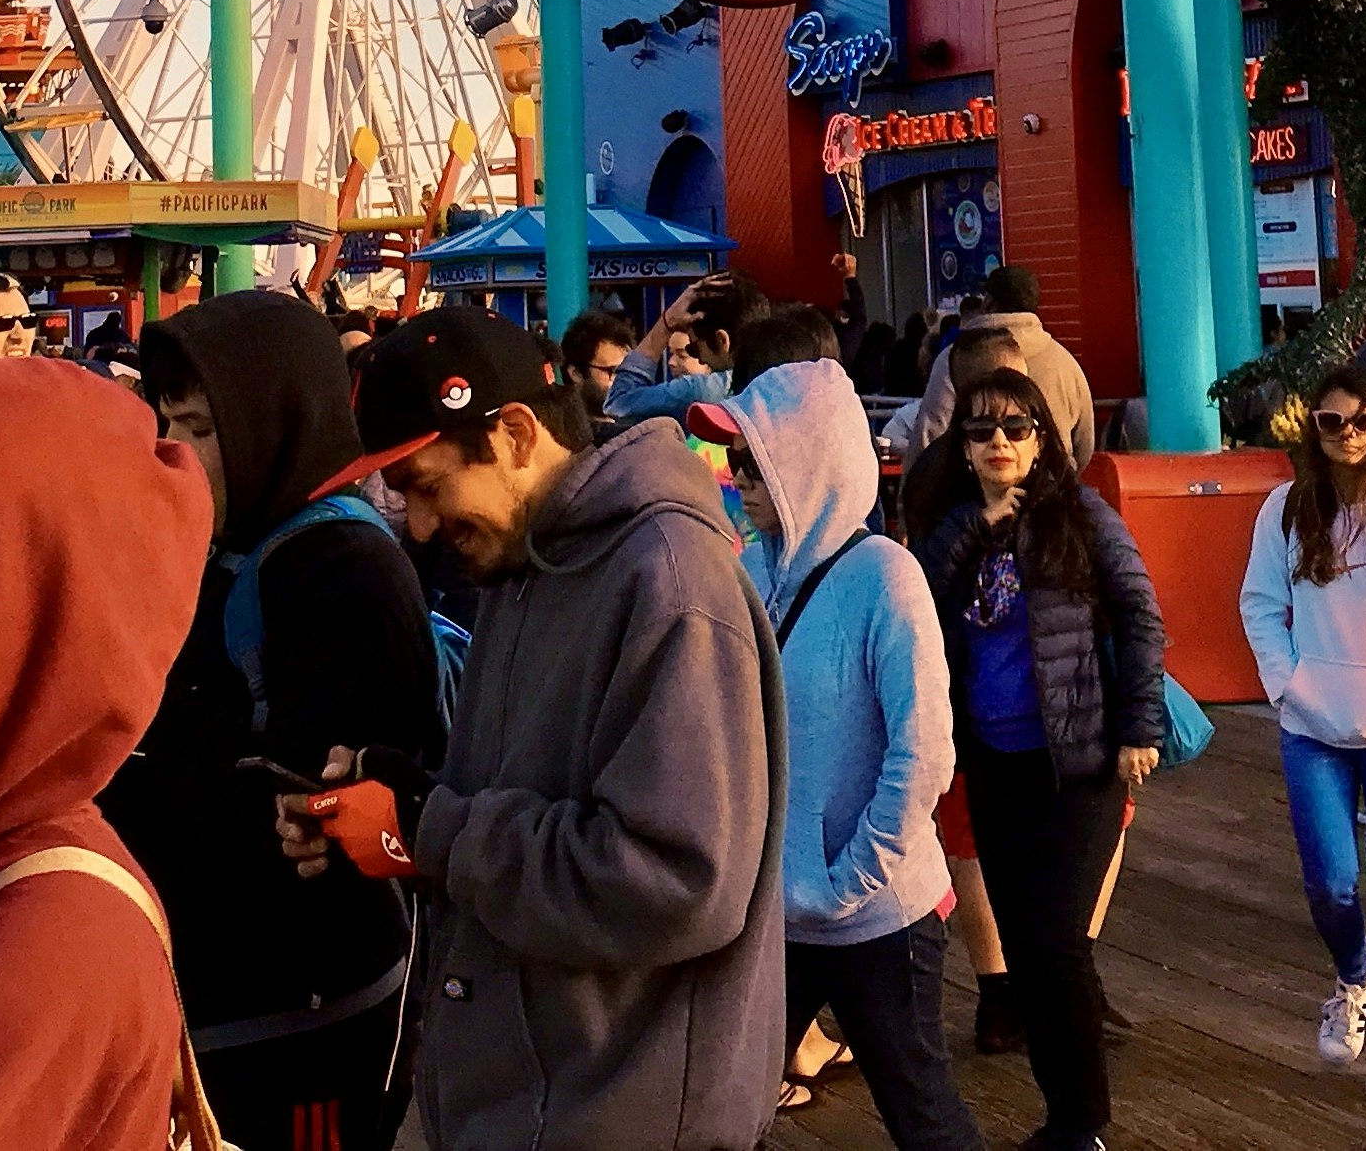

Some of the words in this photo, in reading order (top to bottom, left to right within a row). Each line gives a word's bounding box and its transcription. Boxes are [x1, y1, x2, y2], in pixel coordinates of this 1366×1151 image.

[49, 197, 77, 212] PARK
[160, 193, 268, 216] #PACIFICPARK
[314, 796, 338, 810] GIRO
